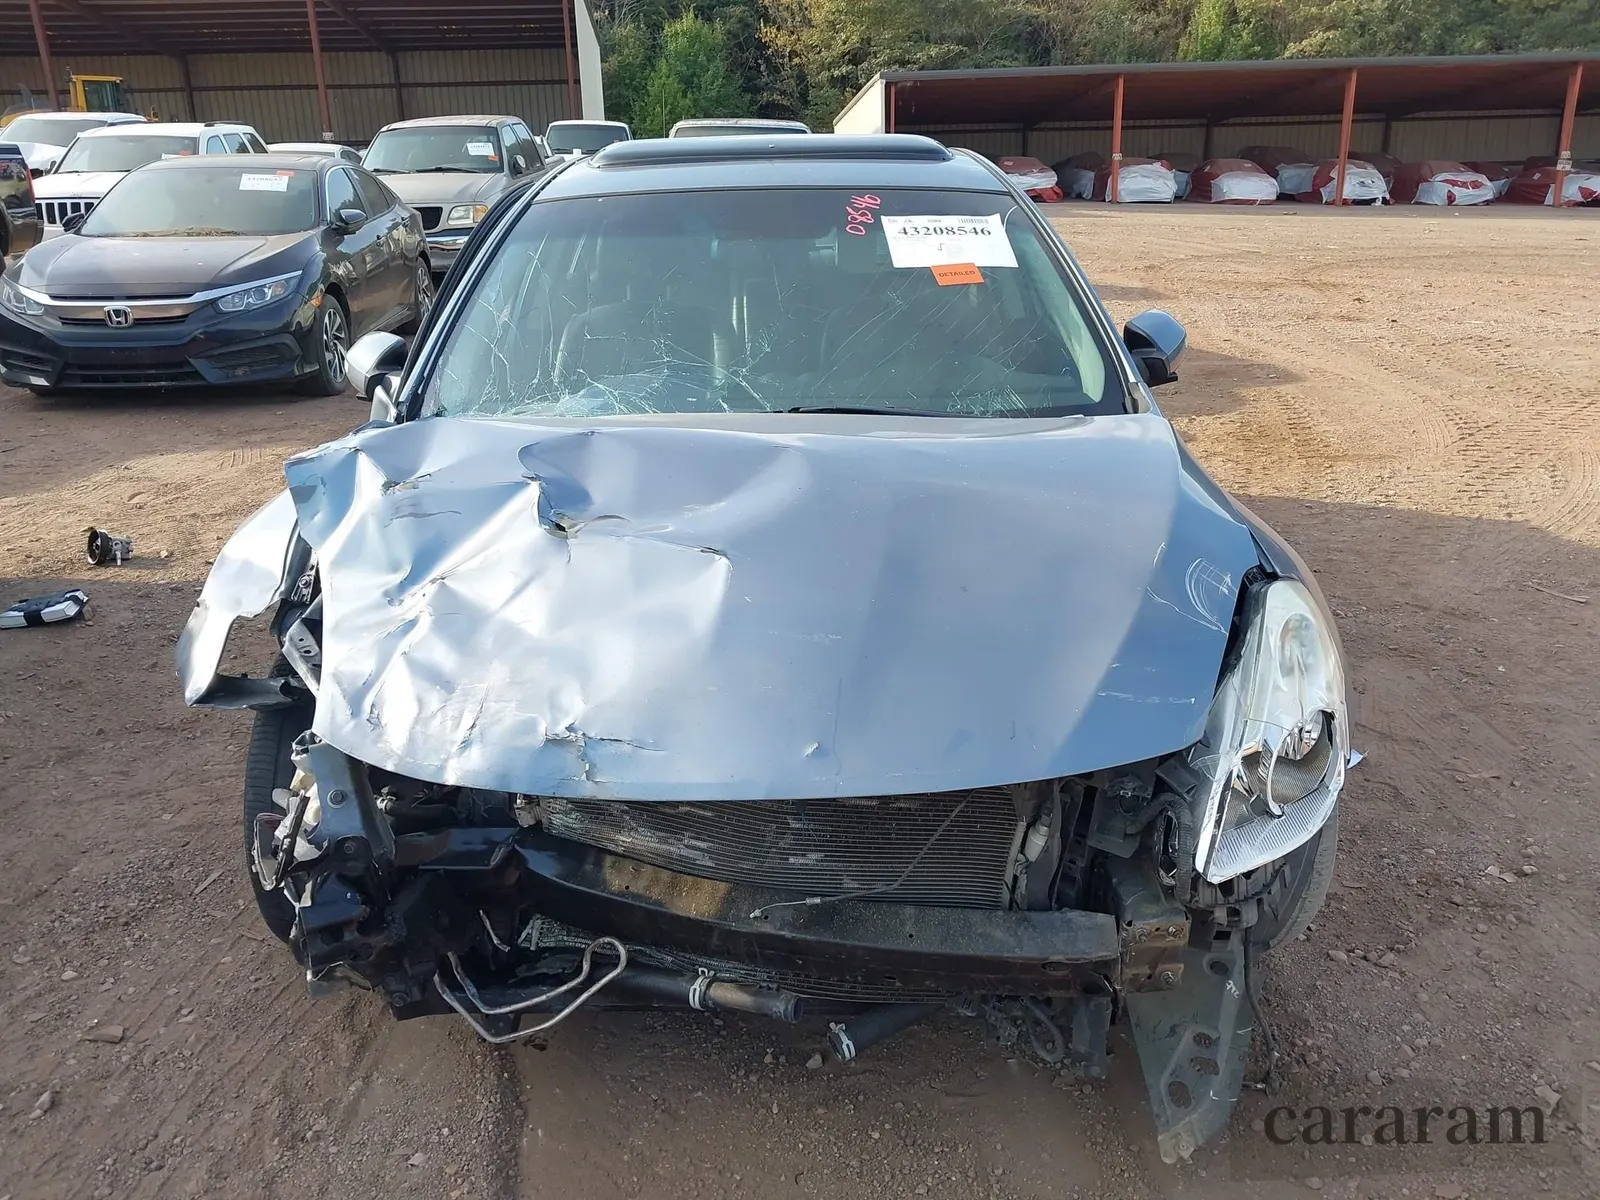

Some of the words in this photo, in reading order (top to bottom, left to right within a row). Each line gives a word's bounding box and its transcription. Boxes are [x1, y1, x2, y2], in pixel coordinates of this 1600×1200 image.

[846, 194, 881, 235] 08546
[897, 226, 992, 236] 43208546
[938, 270, 976, 278] DETAILED
